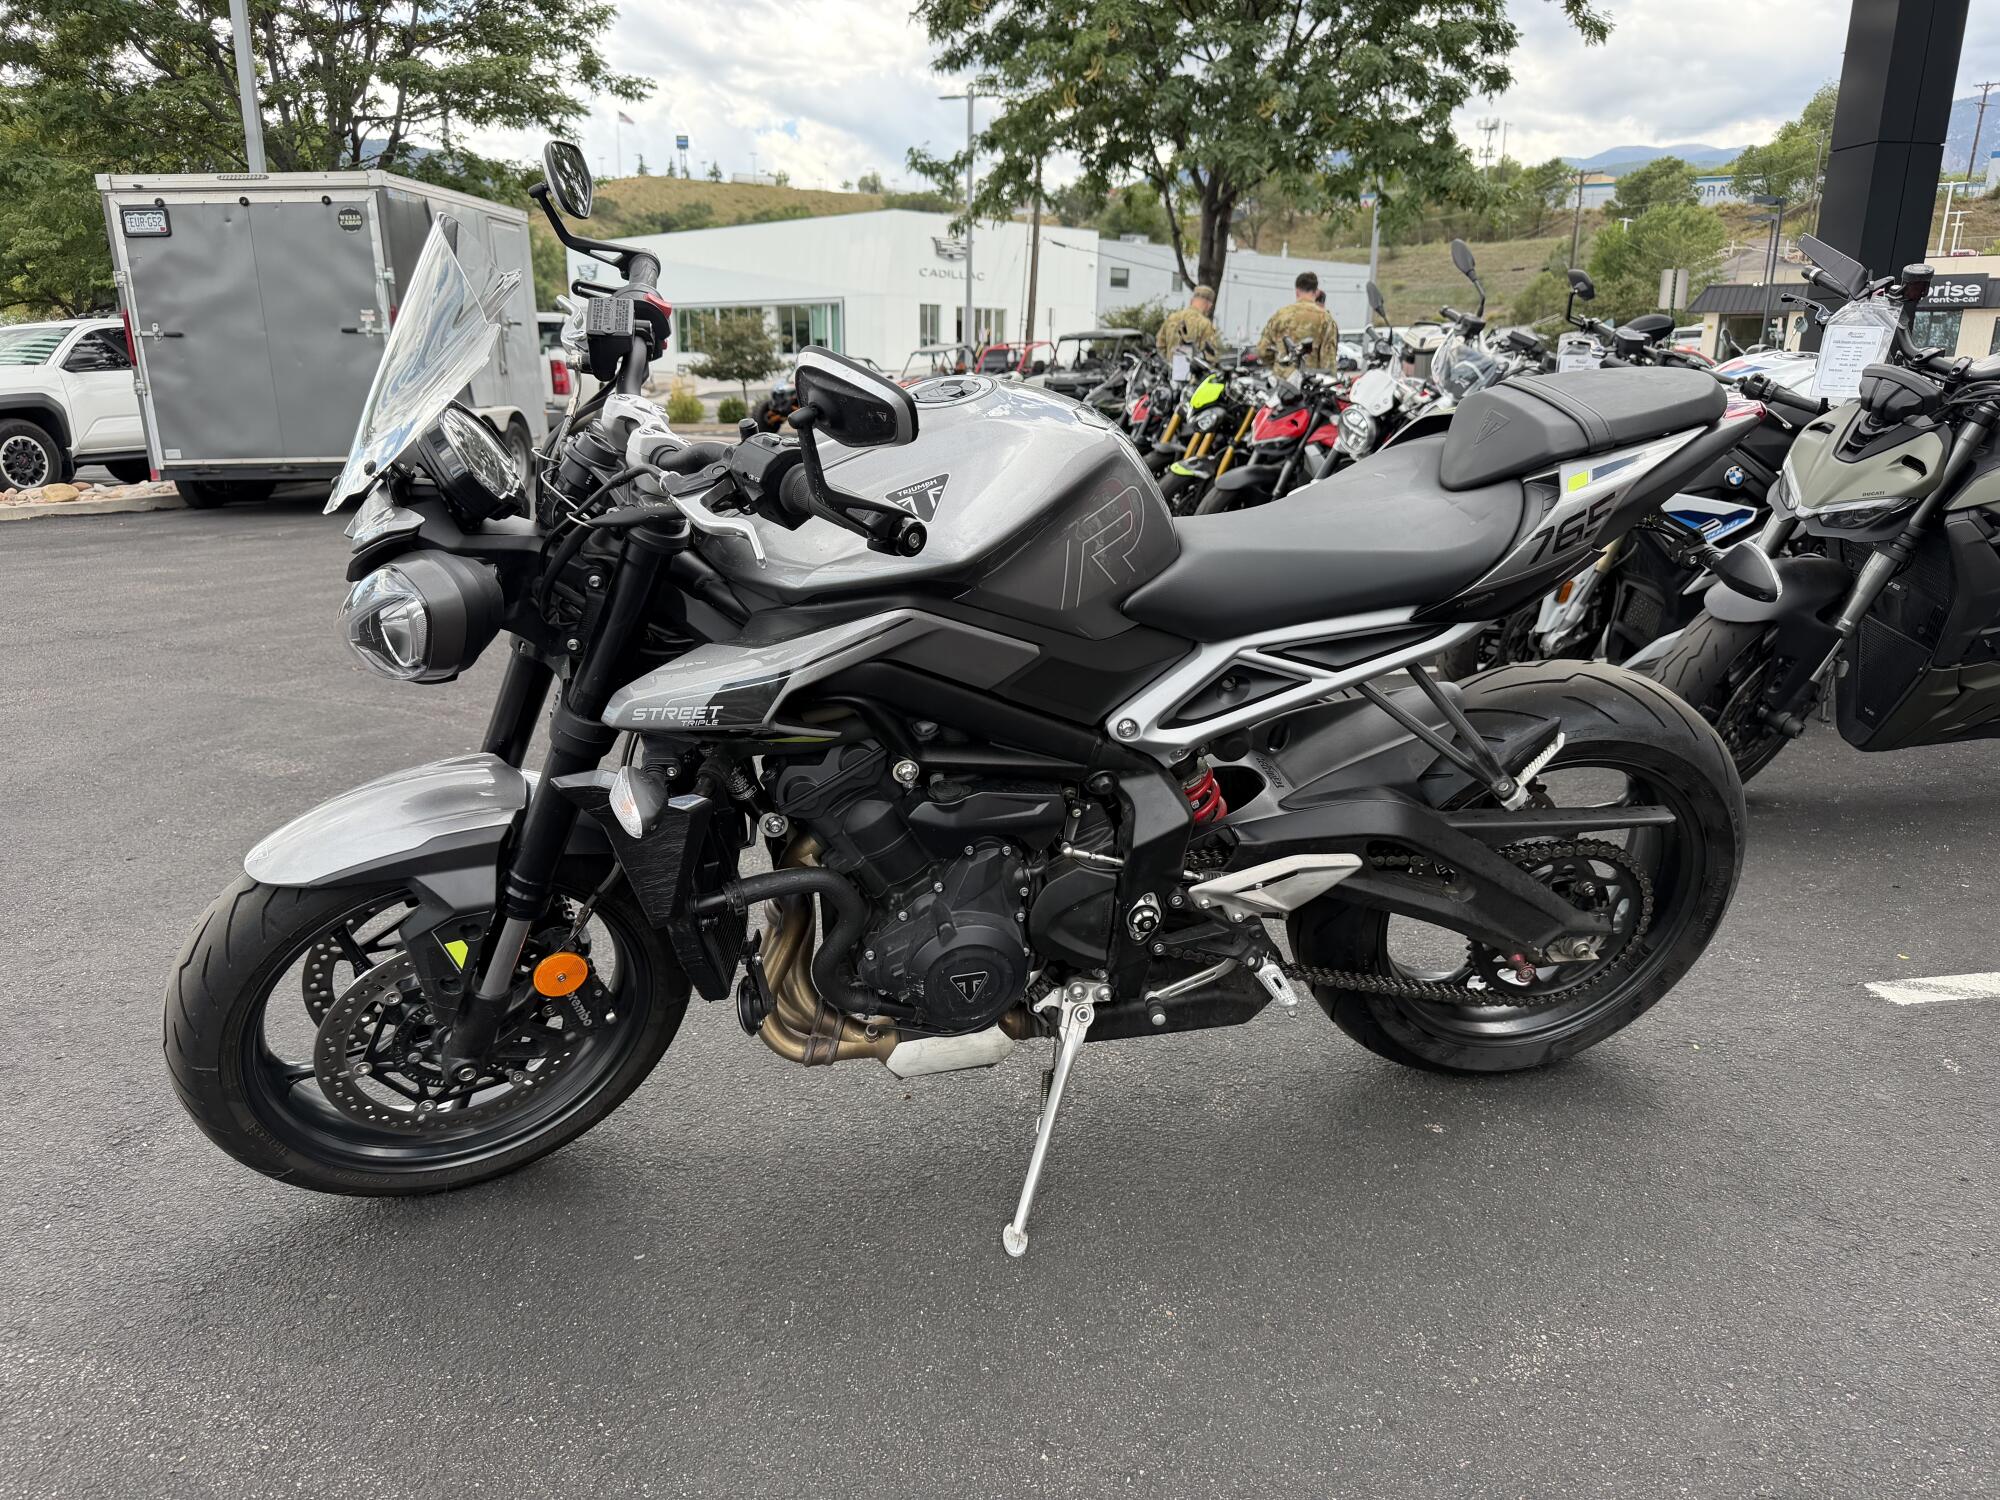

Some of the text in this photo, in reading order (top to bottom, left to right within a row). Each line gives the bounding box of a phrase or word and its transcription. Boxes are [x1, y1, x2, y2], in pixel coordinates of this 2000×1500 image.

[1928, 296, 1980, 304] rent-a-car
[896, 479, 938, 497] TRIUMPH
[1528, 491, 1616, 565] 765
[631, 705, 724, 721] STREET
[680, 719, 720, 728] TRIPLE
